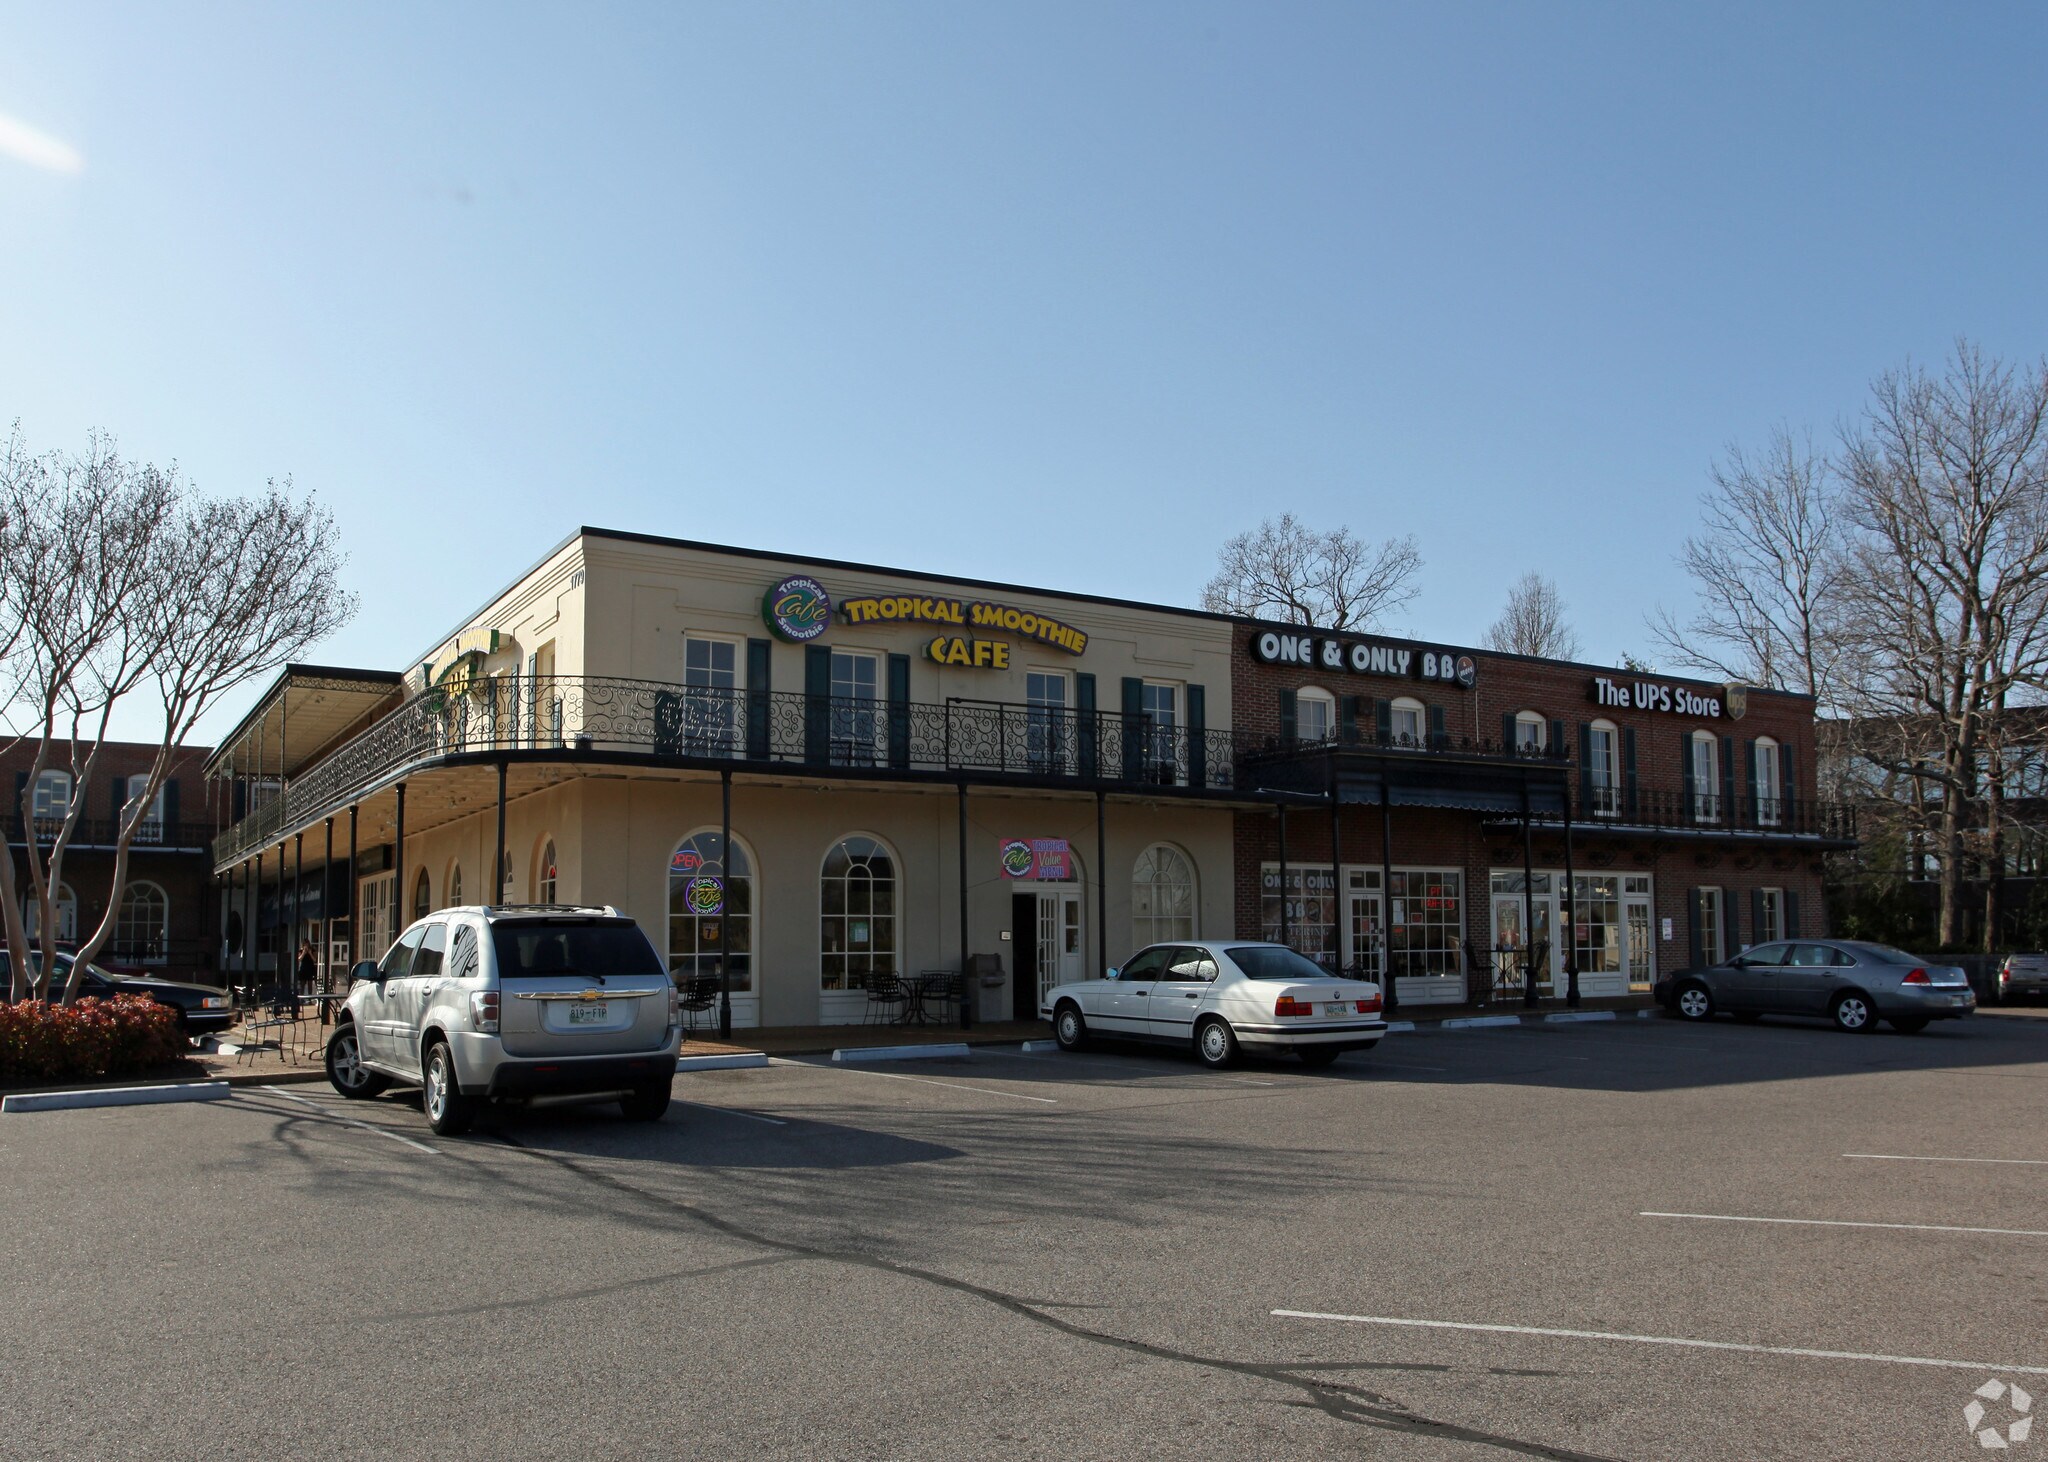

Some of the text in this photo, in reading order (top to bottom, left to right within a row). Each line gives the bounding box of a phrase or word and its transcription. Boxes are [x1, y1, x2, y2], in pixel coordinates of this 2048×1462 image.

[778, 579, 827, 601] Tropical
[778, 616, 824, 639] Smoothie
[845, 597, 1087, 655] TROPICAL SMOOTHIE
[930, 636, 1010, 669] CAFE
[1259, 632, 1311, 663] ONE
[1322, 640, 1342, 667] &
[1351, 644, 1411, 676] ONLY
[1595, 677, 1720, 718] The UPS Store
[1729, 693, 1745, 715] ups
[1032, 840, 1069, 852] TROPICAL
[1038, 851, 1062, 866] Value
[1275, 927, 1329, 936] CTERING
[570, 1007, 607, 1021] 819-FTP
